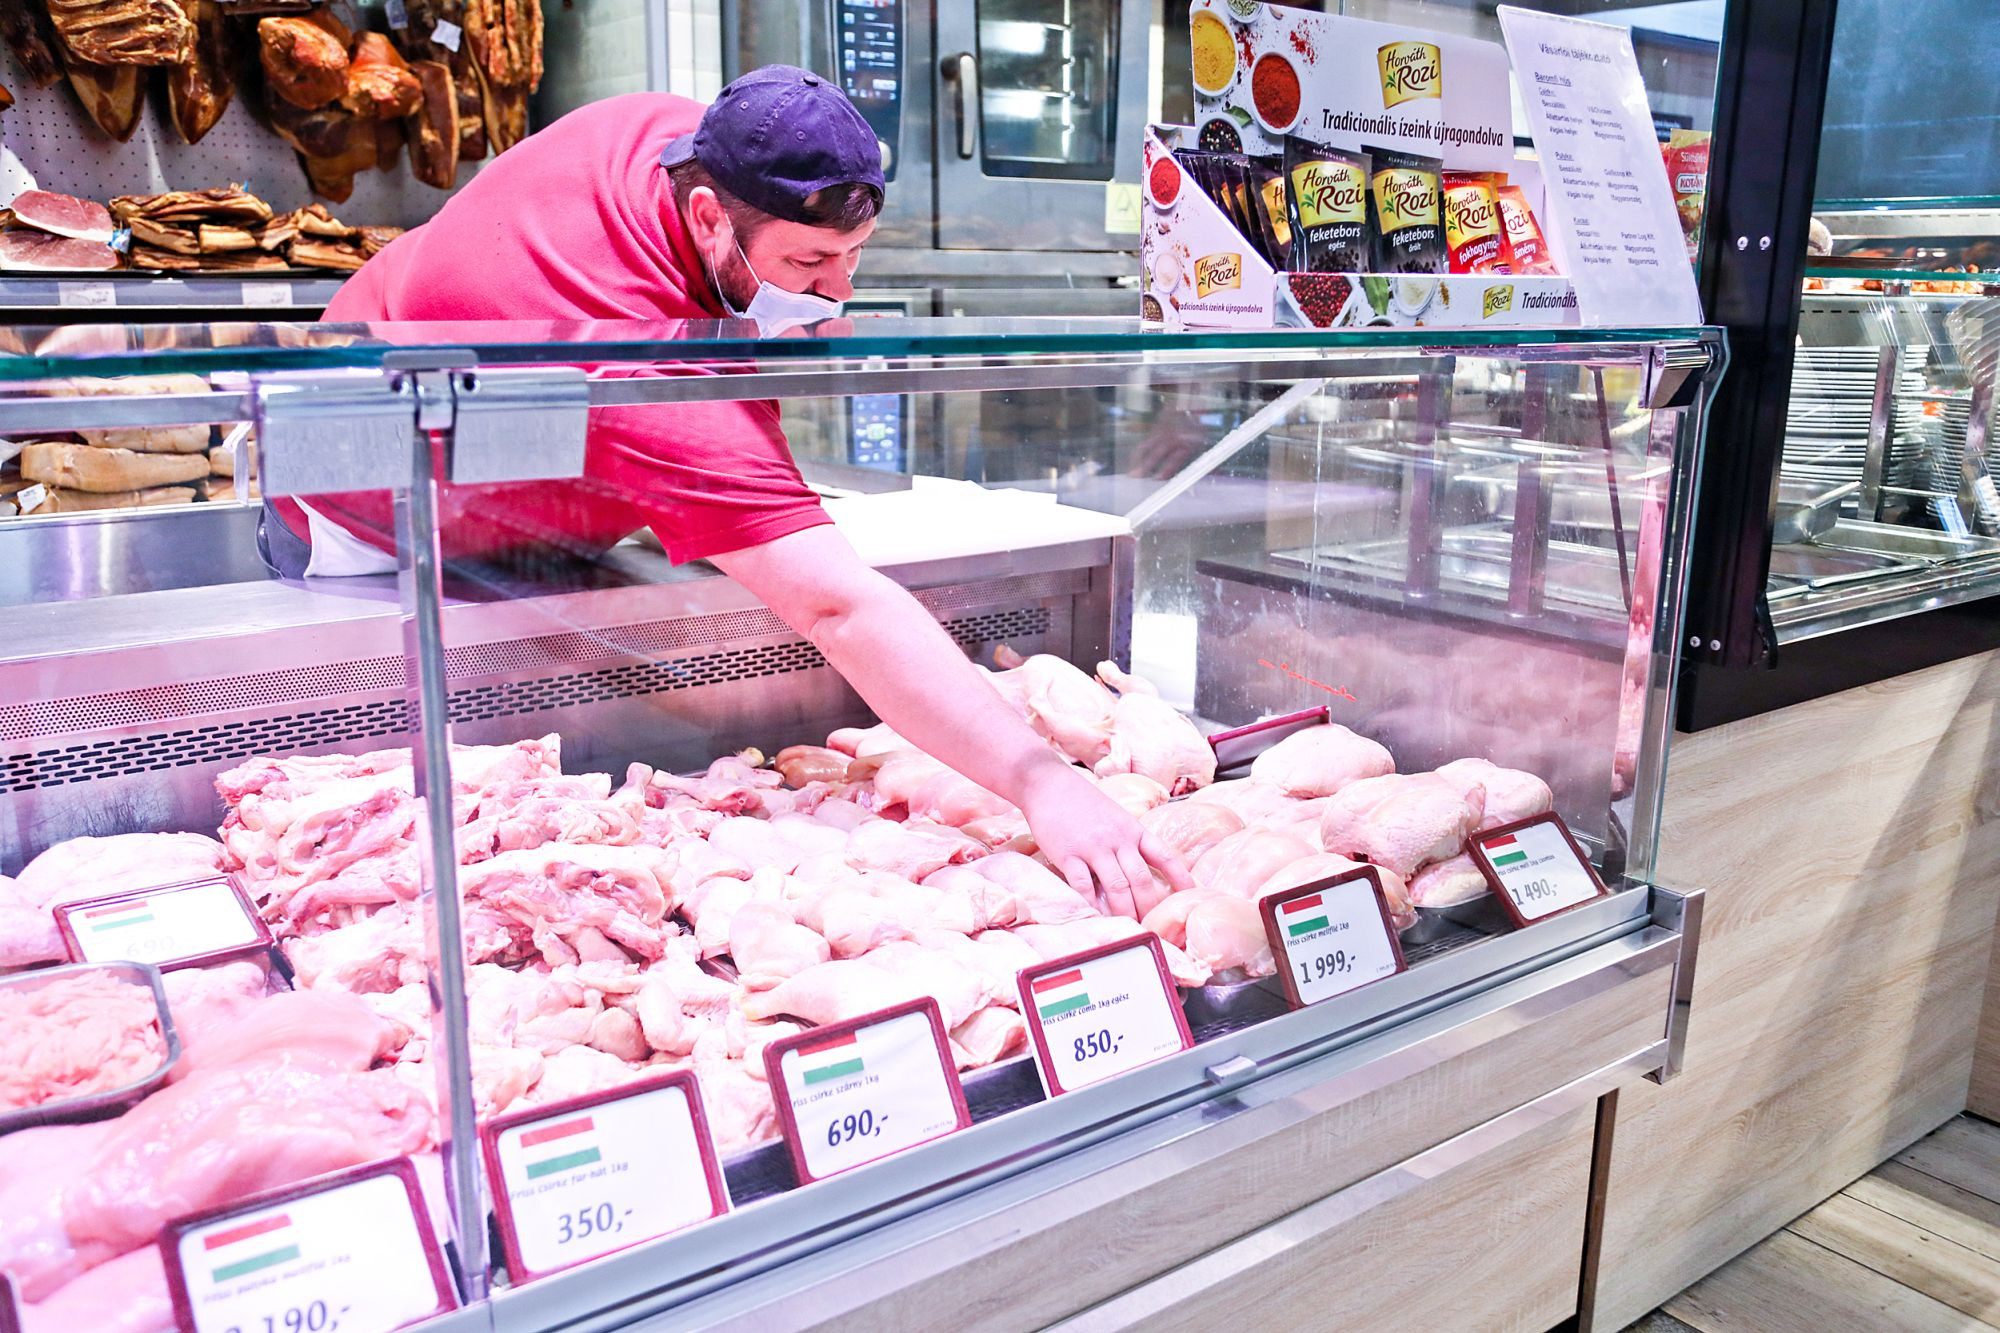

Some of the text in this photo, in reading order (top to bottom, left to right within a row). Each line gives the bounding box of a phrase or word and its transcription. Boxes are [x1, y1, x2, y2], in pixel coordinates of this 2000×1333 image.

[1385, 47, 1426, 71] Horváth
[1396, 60, 1439, 94] Rozi
[1323, 108, 1503, 147] Tradicionális ízeink újragondolva
[1303, 167, 1351, 191] Horváth
[1383, 174, 1424, 197] Horváth
[1316, 183, 1364, 216] Rozi
[1394, 187, 1436, 220] Rozi
[1444, 190, 1481, 214] Horváth
[1455, 200, 1494, 235] Rozi
[1507, 209, 1529, 234] ozi
[1309, 225, 1360, 243] feketebors
[1328, 240, 1346, 251] egész
[1392, 228, 1435, 247] feketebors
[1459, 240, 1499, 264] fokhagyma-
[1514, 242, 1536, 260] ömény
[1200, 255, 1230, 273] Horváth
[1207, 263, 1238, 289] Rozi
[1179, 302, 1208, 311] radicionális
[1226, 303, 1263, 314] újragondolva
[1490, 292, 1511, 311] Rozi
[1522, 290, 1577, 309] Tradicionális
[1512, 878, 1557, 906] 1 490,-
[1286, 938, 1300, 948] Friss
[1301, 931, 1317, 942] csirke
[1300, 962, 1312, 984] 1
[1315, 949, 1356, 979] 999,-
[1043, 1017, 1056, 1027] riss
[1057, 1009, 1077, 1023] csirke
[1098, 999, 1110, 1009] 1kg
[1111, 993, 1130, 1005] egész
[1073, 1028, 1124, 1062] 850,-
[793, 1098, 808, 1108] riss
[810, 1087, 834, 1103] csirke
[827, 1109, 889, 1147] 690,-
[557, 1201, 634, 1245] 350,-
